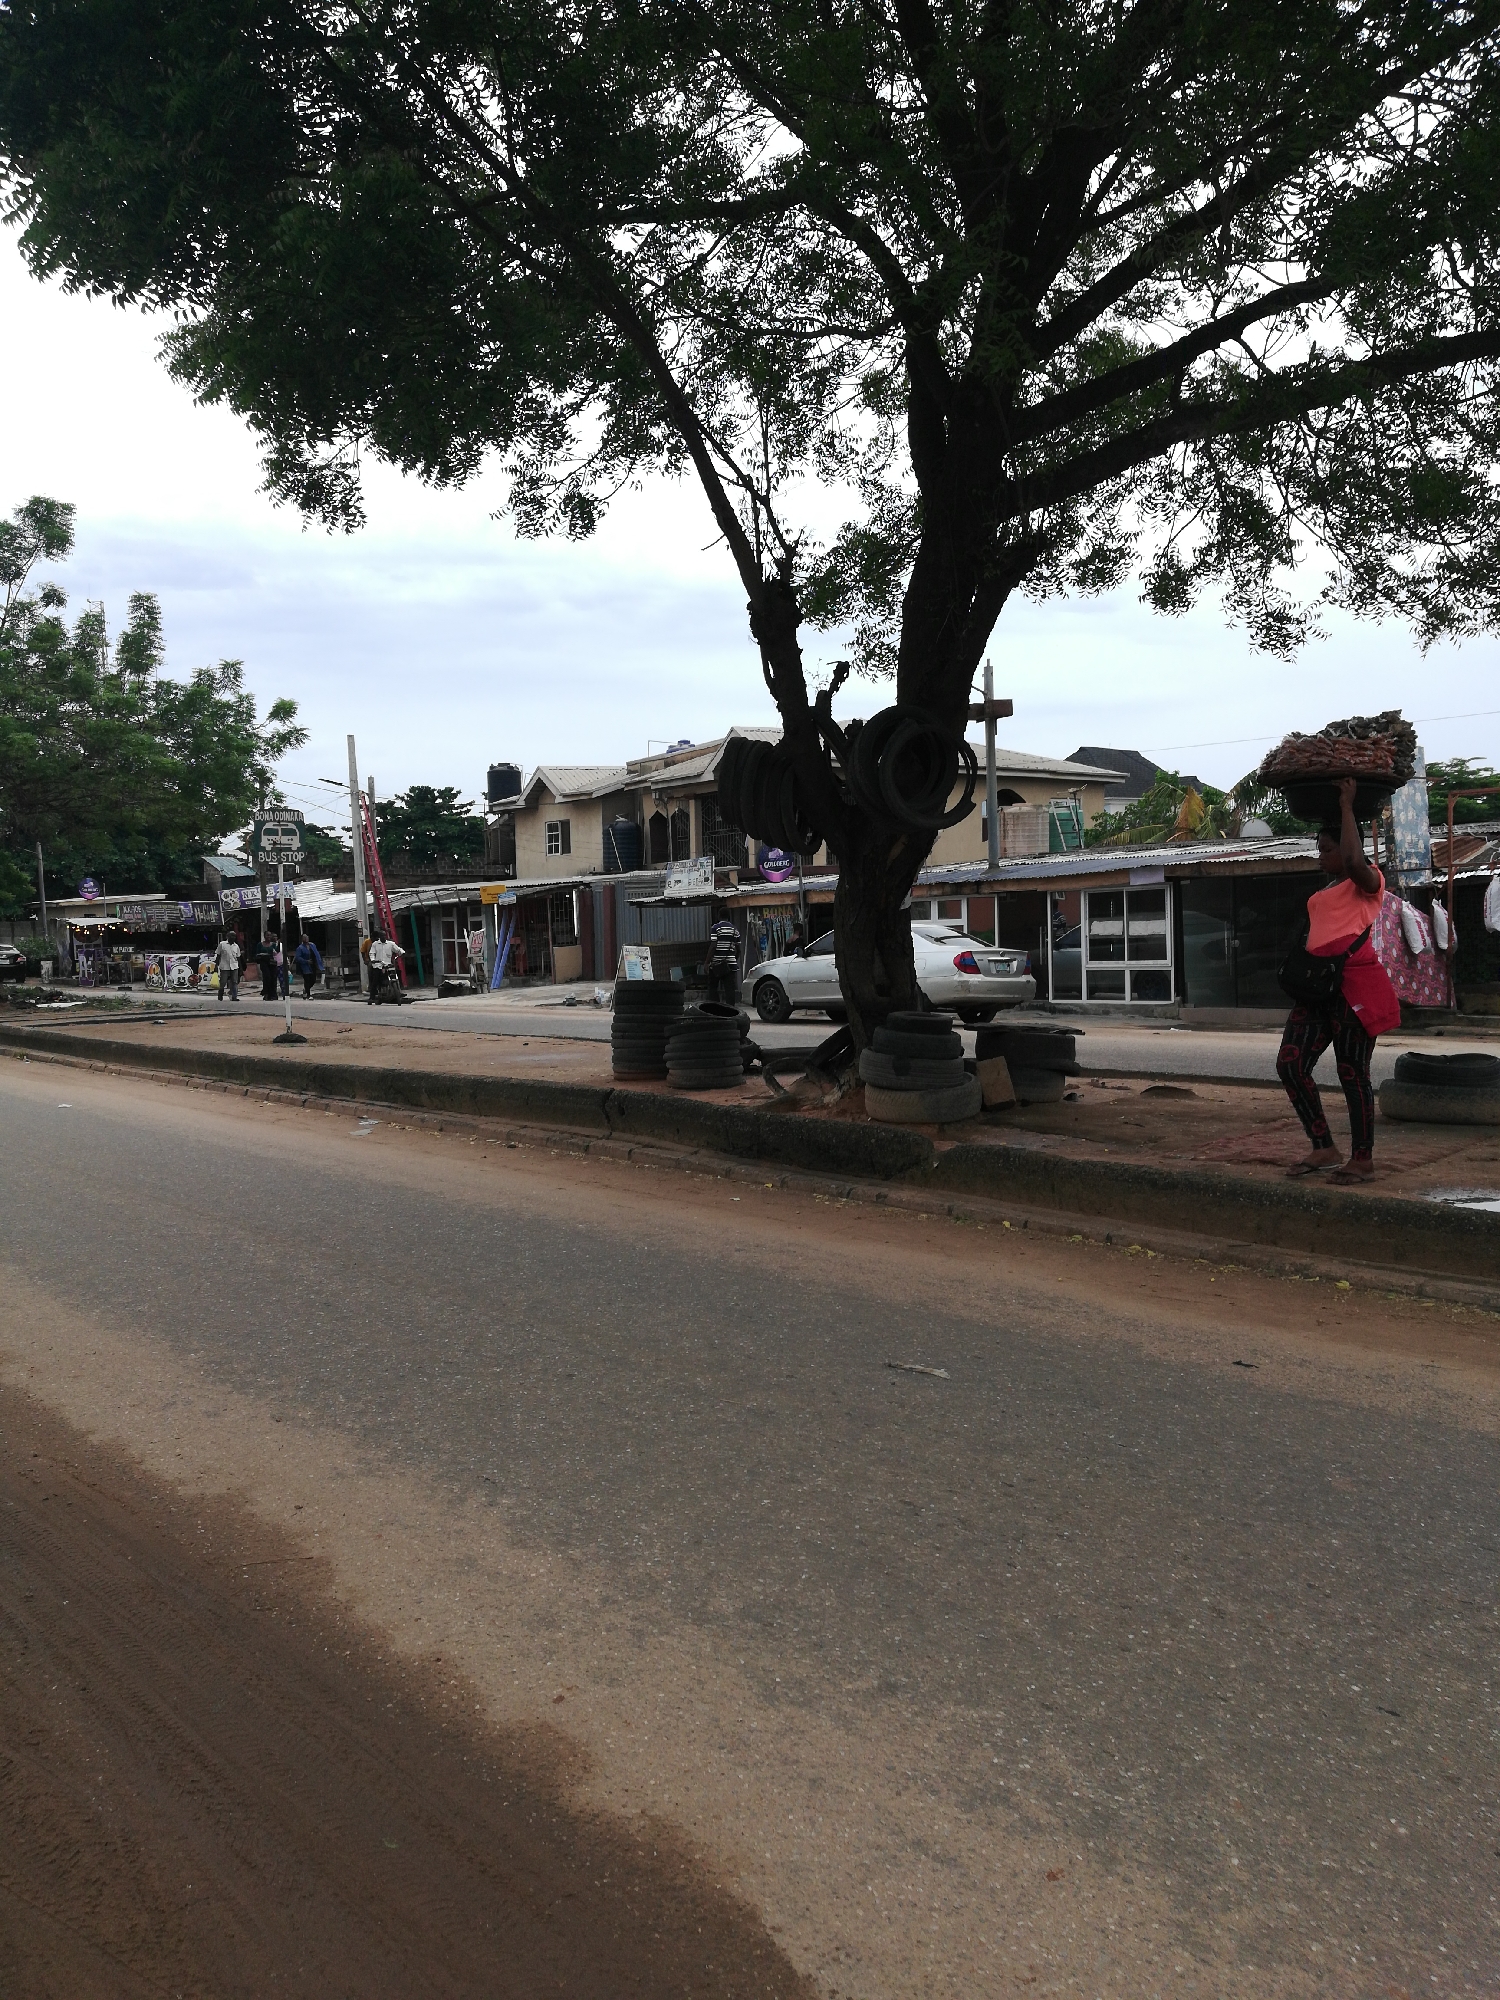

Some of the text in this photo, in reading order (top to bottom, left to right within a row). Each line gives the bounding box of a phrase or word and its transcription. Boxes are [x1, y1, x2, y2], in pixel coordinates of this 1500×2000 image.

[255, 811, 304, 821] BONA ODINAKA
[764, 860, 790, 869] GOLDBERG
